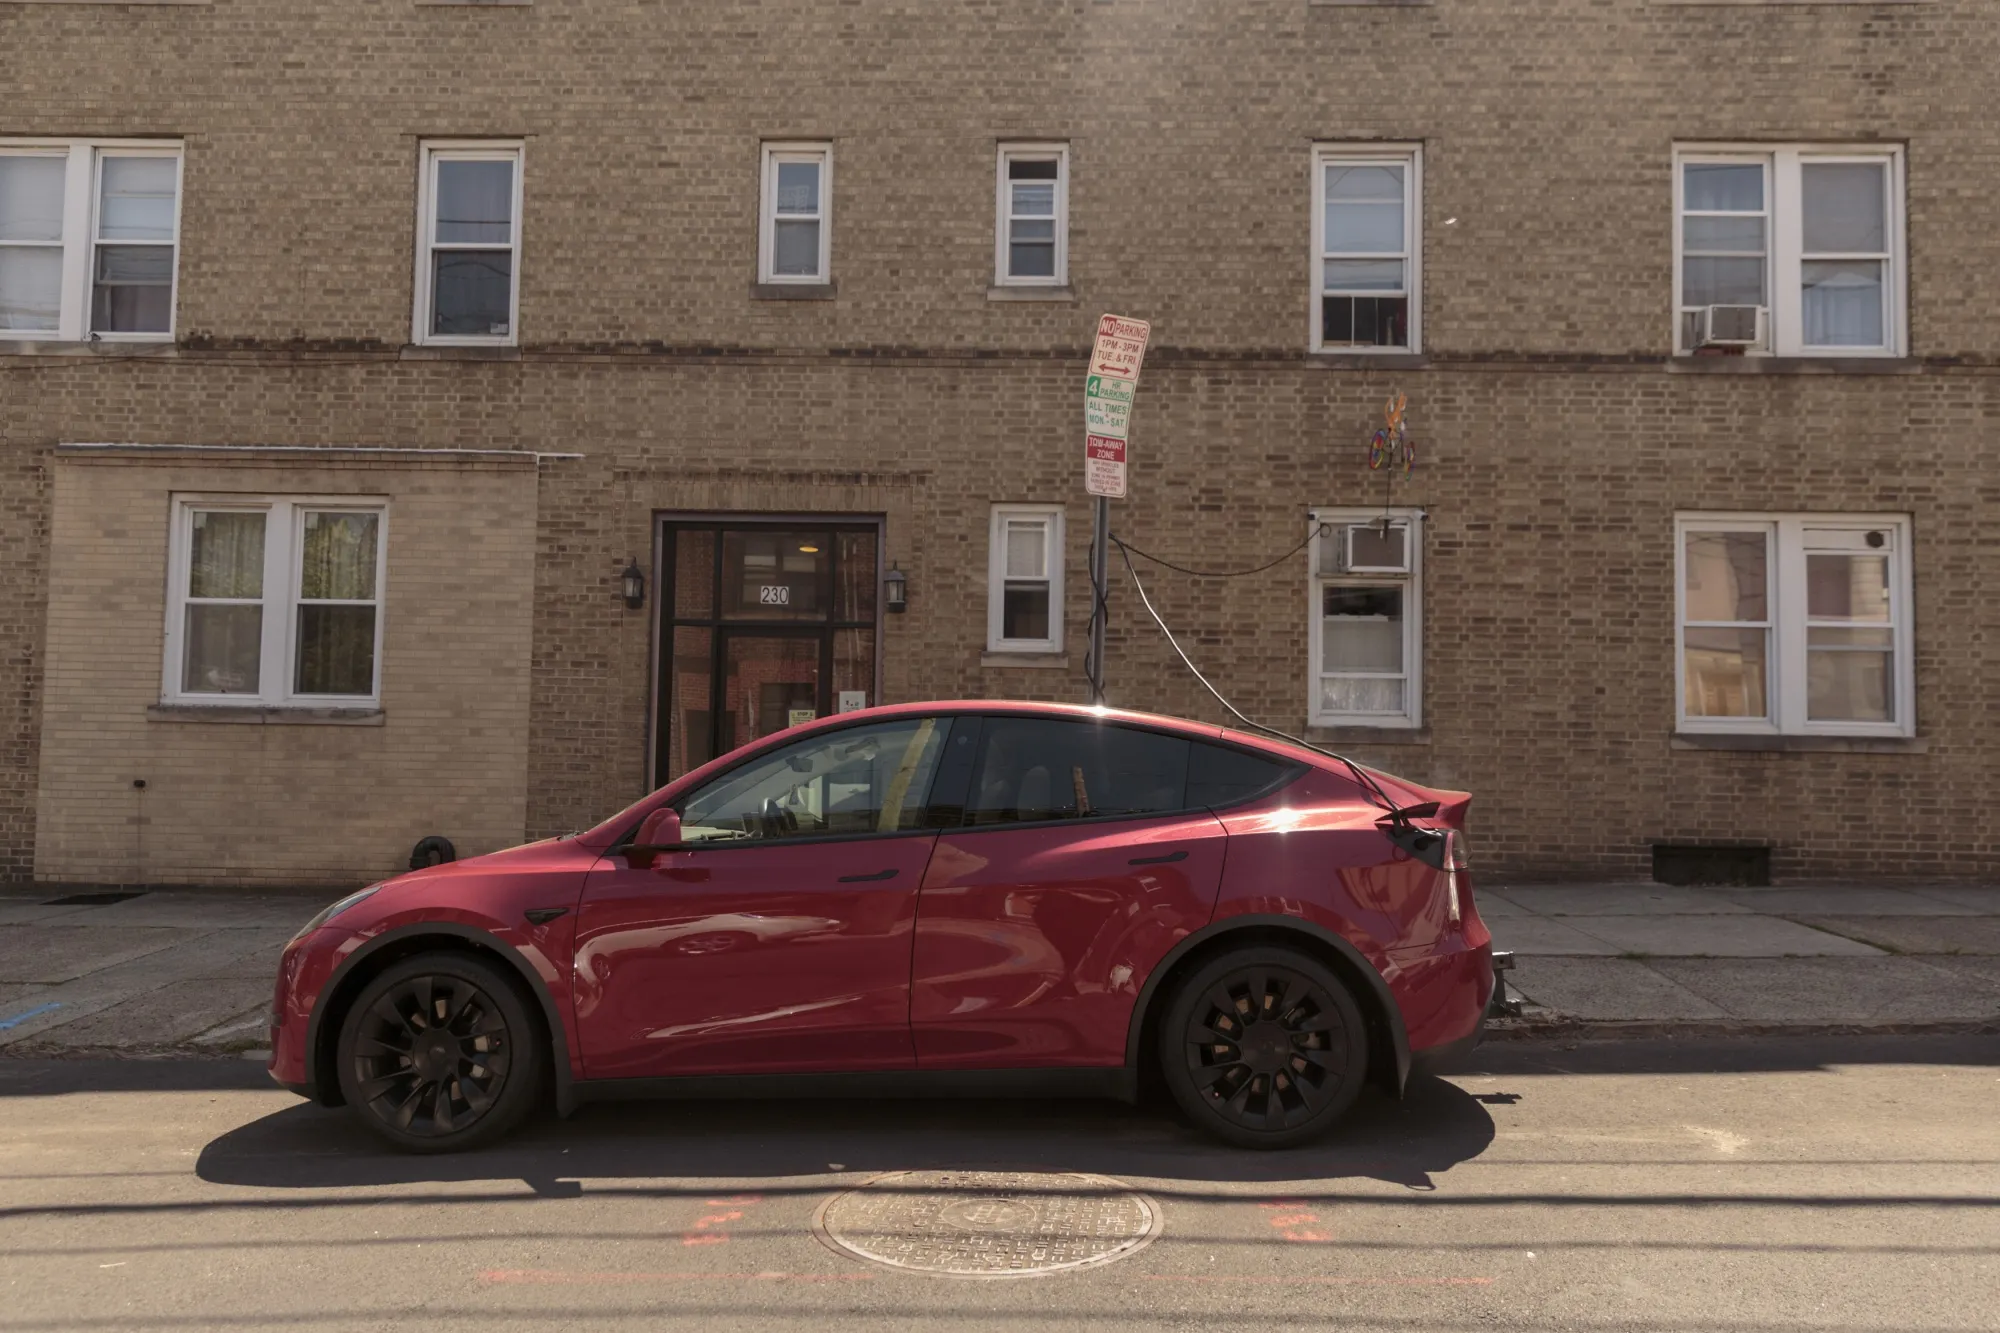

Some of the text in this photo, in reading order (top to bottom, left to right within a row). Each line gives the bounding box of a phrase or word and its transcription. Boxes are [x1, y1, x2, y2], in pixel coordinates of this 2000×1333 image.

[1100, 319, 1147, 339] NO PARKING
[1102, 340, 1118, 350] 1PM
[1122, 343, 1140, 353] 3PM
[1115, 354, 1122, 362] &
[1089, 380, 1098, 395] 4
[1100, 389, 1130, 400] PARKING
[1089, 400, 1127, 415] ALL TIMES
[1089, 437, 1124, 450] TOW-AWAY
[1097, 449, 1115, 460] ZONE
[762, 586, 788, 603] 230
